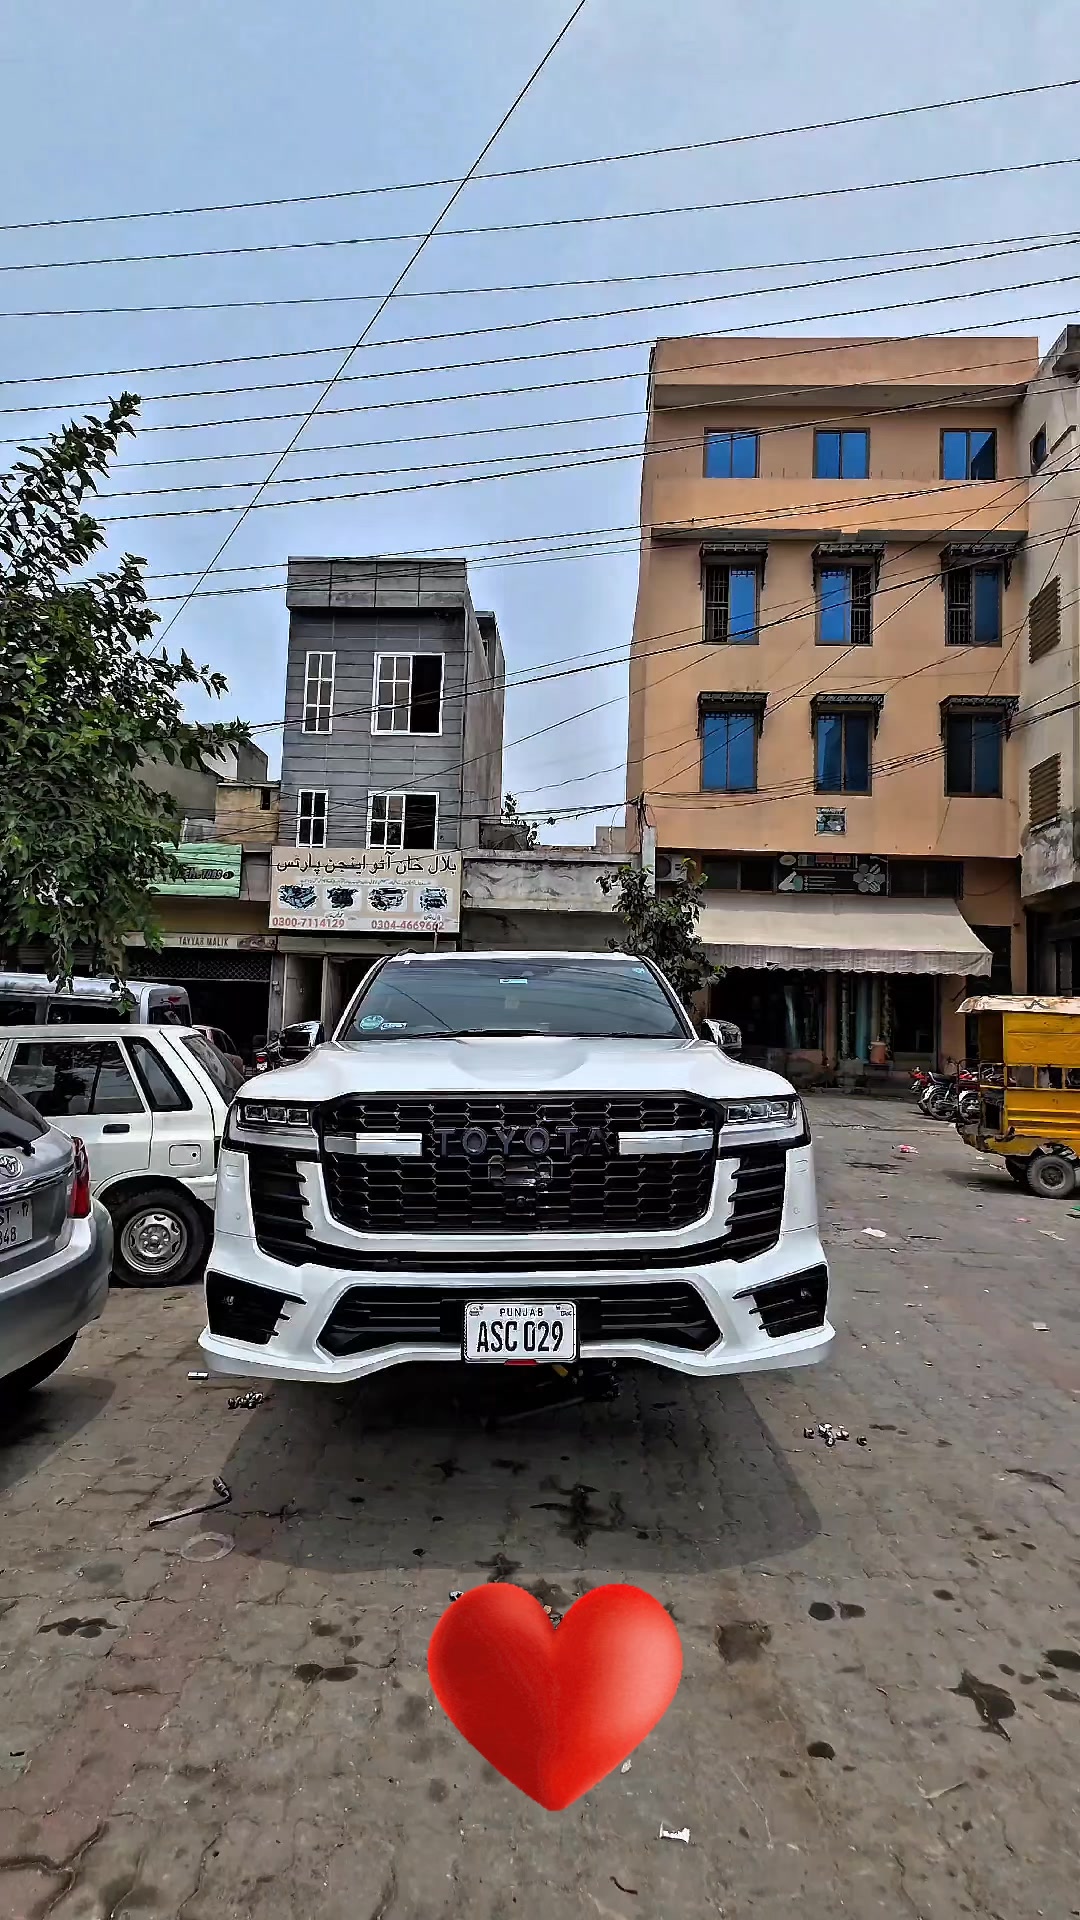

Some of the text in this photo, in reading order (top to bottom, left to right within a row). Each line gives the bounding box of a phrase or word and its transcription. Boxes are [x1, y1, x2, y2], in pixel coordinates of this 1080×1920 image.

[395, 854, 424, 875] خان
[428, 854, 457, 875] بلال
[272, 916, 345, 928] 0300-7114129
[206, 936, 229, 947] MALIK
[433, 1126, 613, 1156] TOYOTA
[499, 1307, 544, 1317] PUNJAB
[476, 1320, 564, 1353] ASC 029
